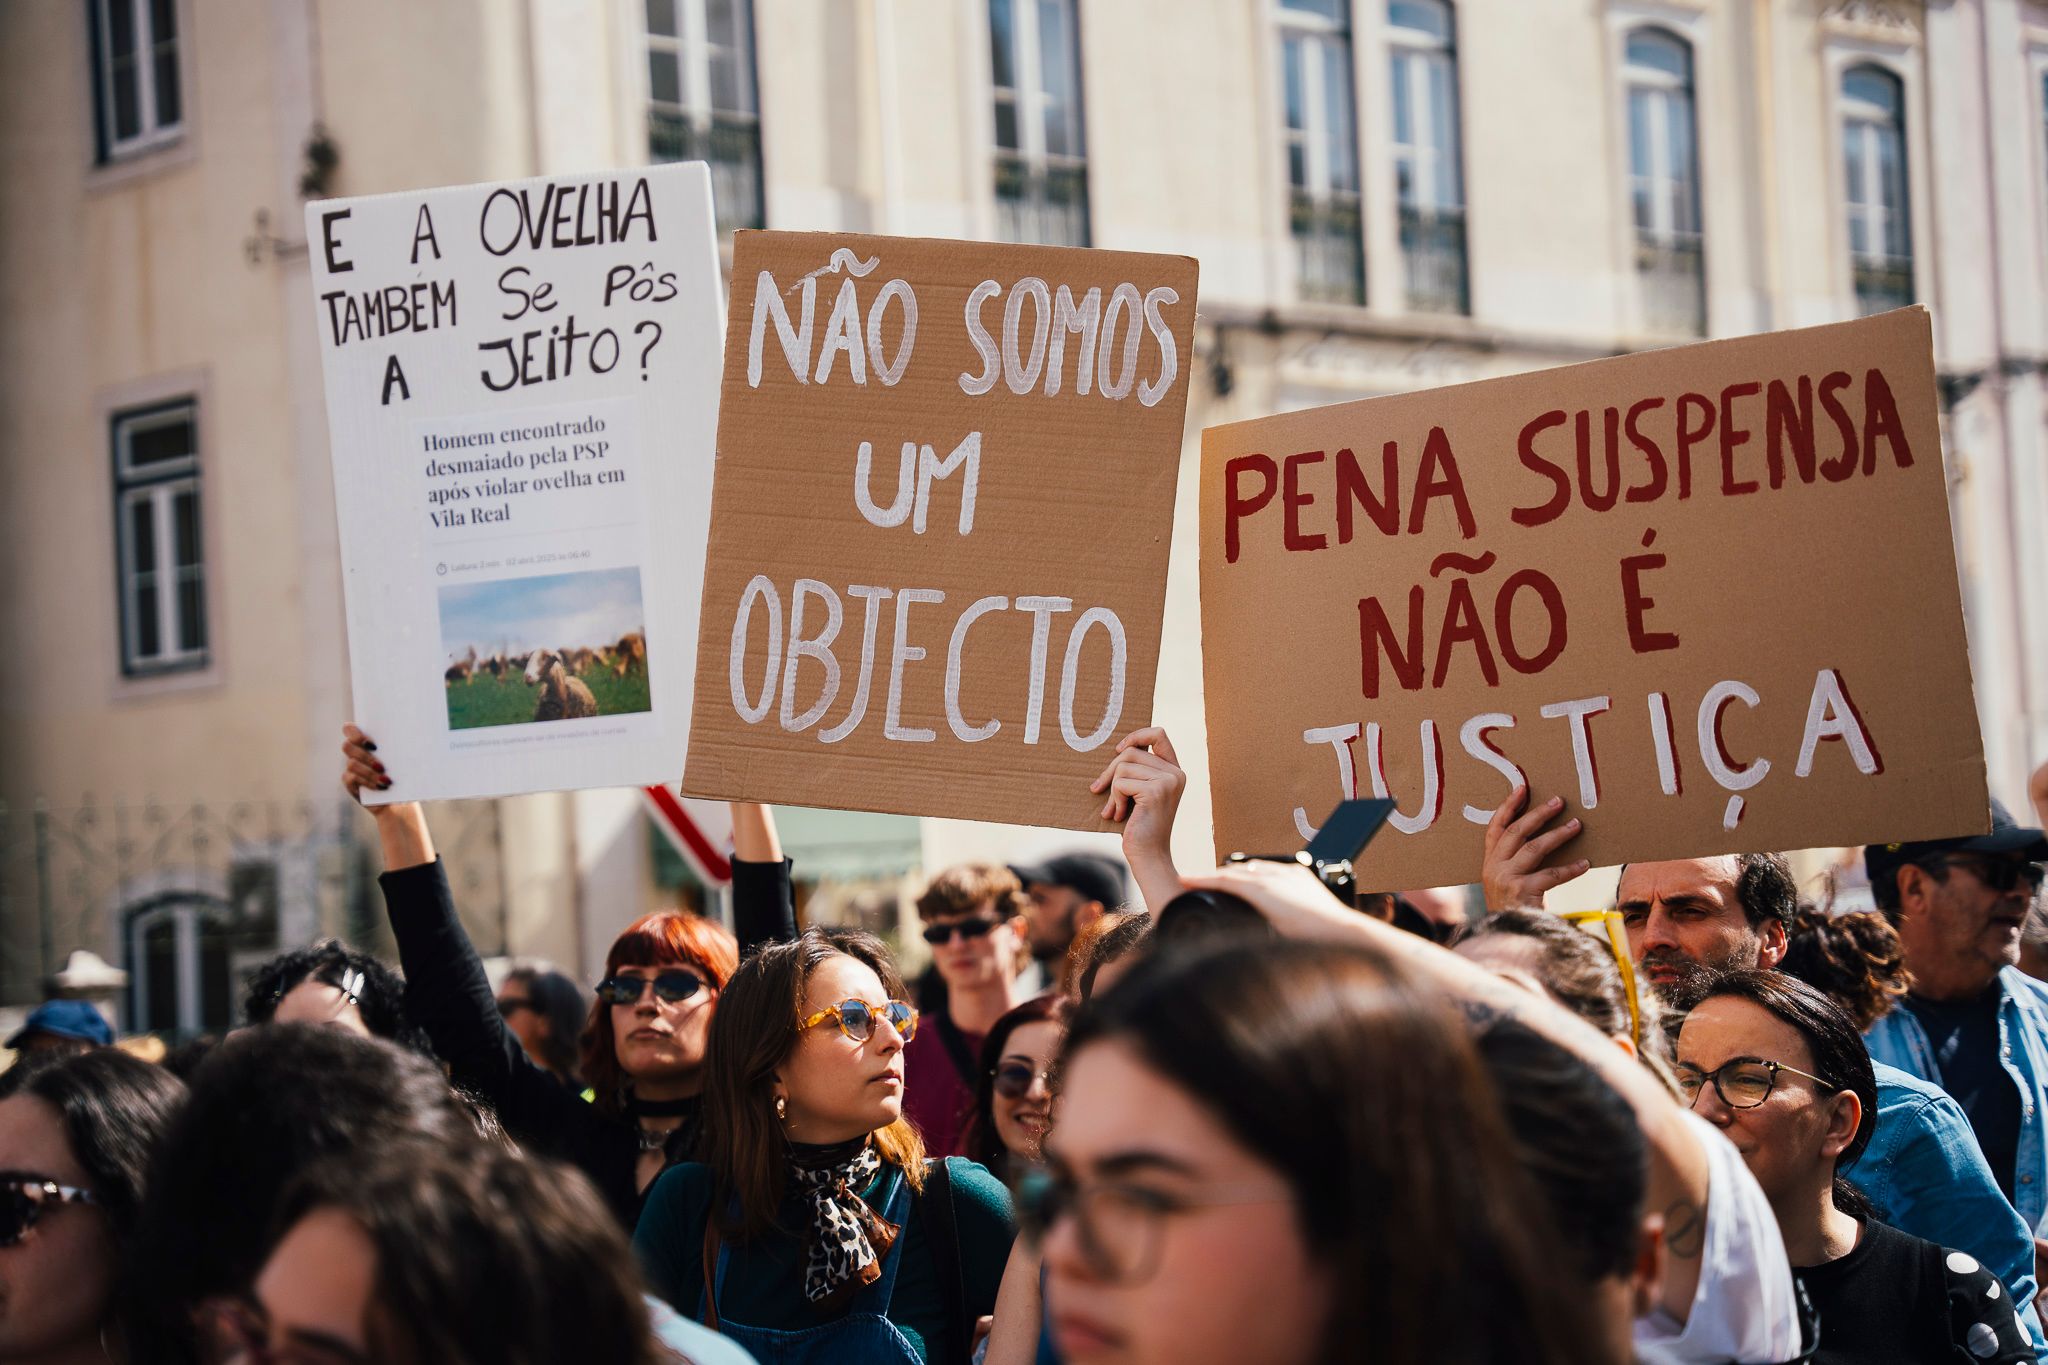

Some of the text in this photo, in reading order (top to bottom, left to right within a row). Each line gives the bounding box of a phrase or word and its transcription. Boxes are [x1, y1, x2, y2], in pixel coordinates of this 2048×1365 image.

[321, 178, 658, 274] E A OVELHA
[321, 271, 458, 347] TAMBÉM
[747, 248, 1181, 407] NÃO SOMOS
[381, 355, 410, 406] A
[423, 415, 606, 452] Homem encontrado
[426, 441, 609, 477] desmaiado pela PSP
[1224, 368, 1914, 564] PENA SUSPENSA
[428, 468, 625, 505] após violar ovelha em
[430, 503, 511, 528] Vila Real
[854, 431, 982, 536] UM
[1358, 528, 1680, 699] NÃO É
[730, 575, 1127, 752] OBJECTO
[1294, 668, 1885, 841] JUSTIÇA
